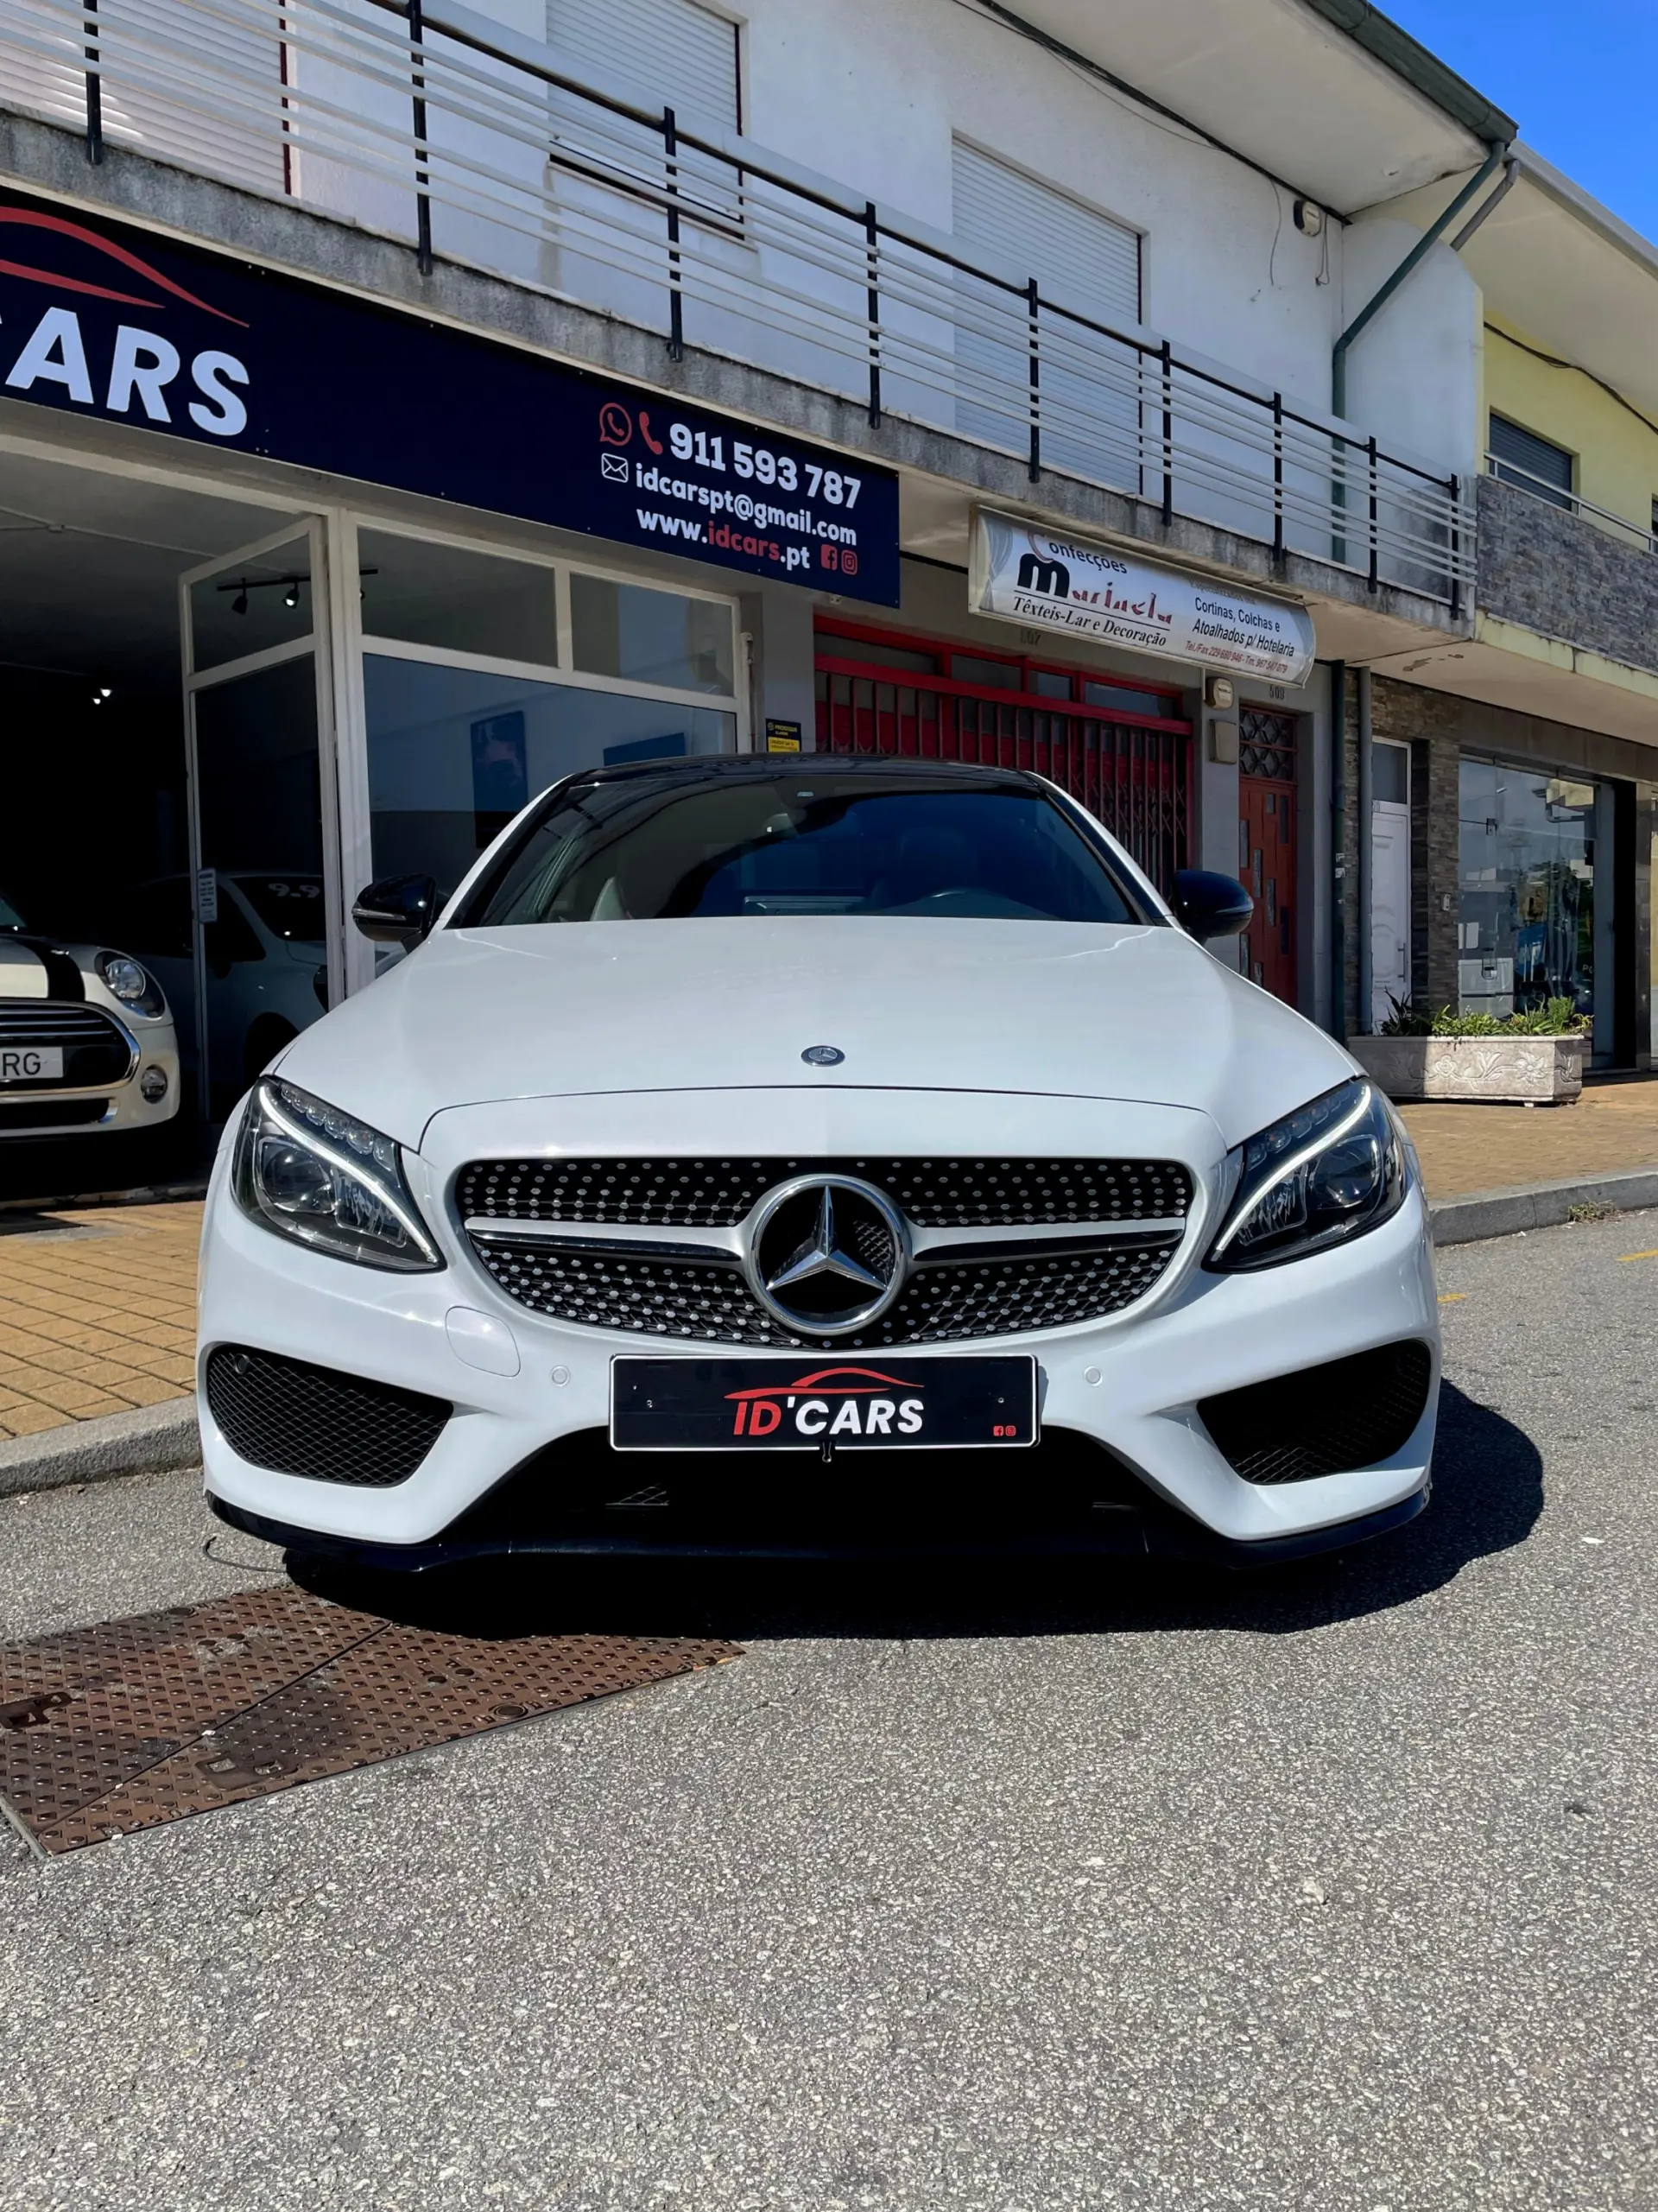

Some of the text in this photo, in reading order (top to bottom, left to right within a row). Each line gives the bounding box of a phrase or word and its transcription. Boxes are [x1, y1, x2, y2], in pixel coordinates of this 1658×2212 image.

[0, 306, 250, 436] ARS
[669, 423, 862, 509] 911 593 787
[636, 462, 857, 546] idcarspt@gmail.com
[636, 508, 811, 570] www.idcars.pt
[1013, 596, 1168, 647] Têxteis-Lar e Decoração
[1192, 618, 1295, 656] Atoalhados p/ Hotelaria
[1195, 597, 1281, 632] Cortinas, Colchas e
[2, 1052, 41, 1076] RG
[733, 1396, 925, 1436] ID'CARS
